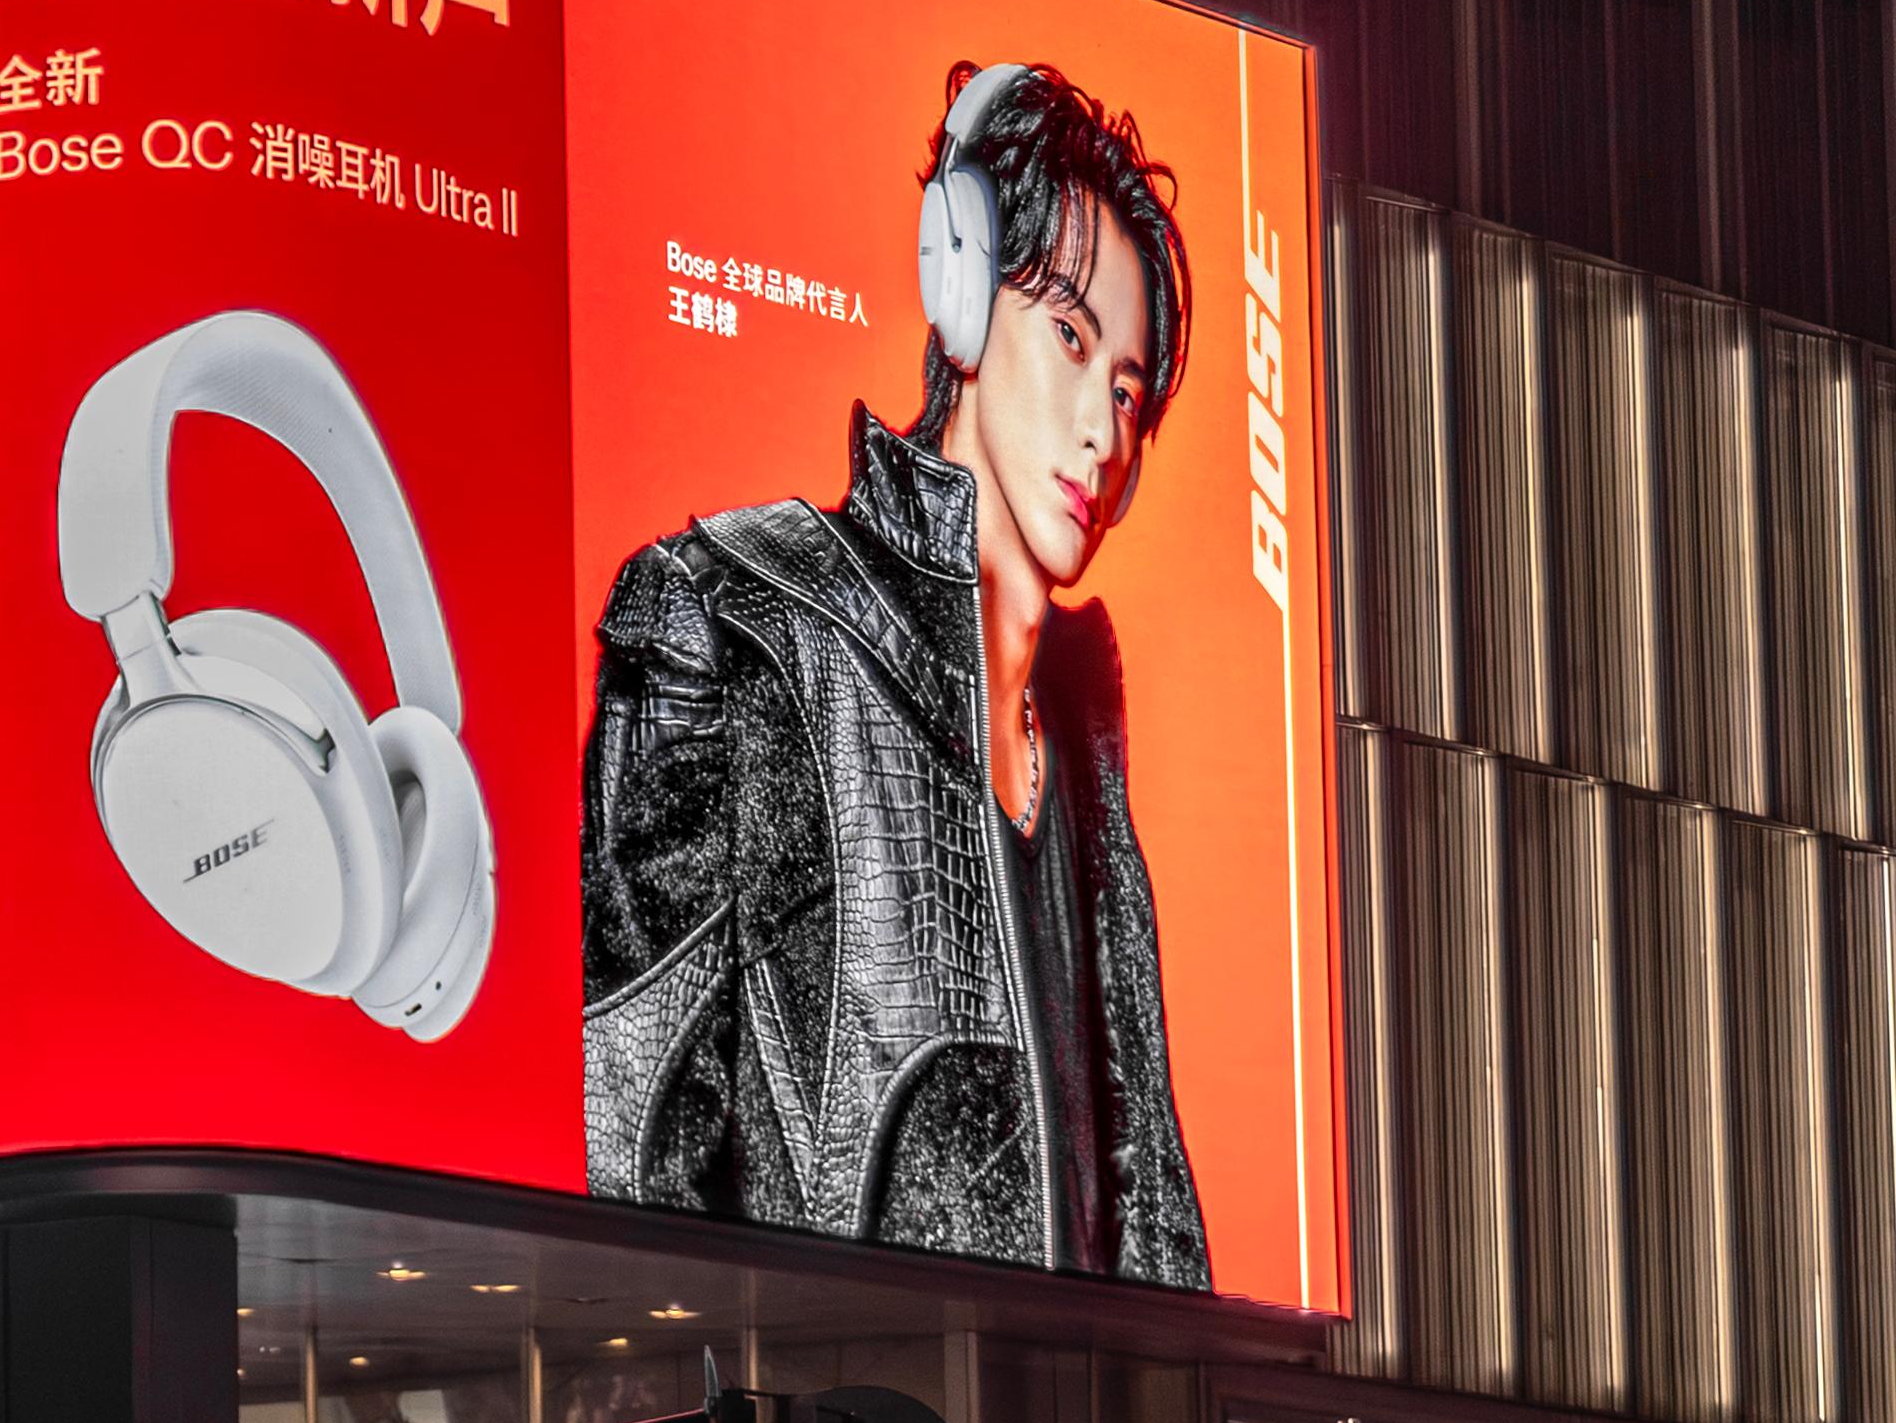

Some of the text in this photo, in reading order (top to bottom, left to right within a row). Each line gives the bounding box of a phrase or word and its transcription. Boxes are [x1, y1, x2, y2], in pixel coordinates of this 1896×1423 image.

[141, 118, 234, 172] QC
[249, 121, 407, 211] 消噪耳机
[414, 162, 495, 232] Ultra
[667, 241, 869, 327] Bose 全球品牌代言人
[1243, 209, 1288, 612] BOSE
[189, 824, 269, 879] BOSE
